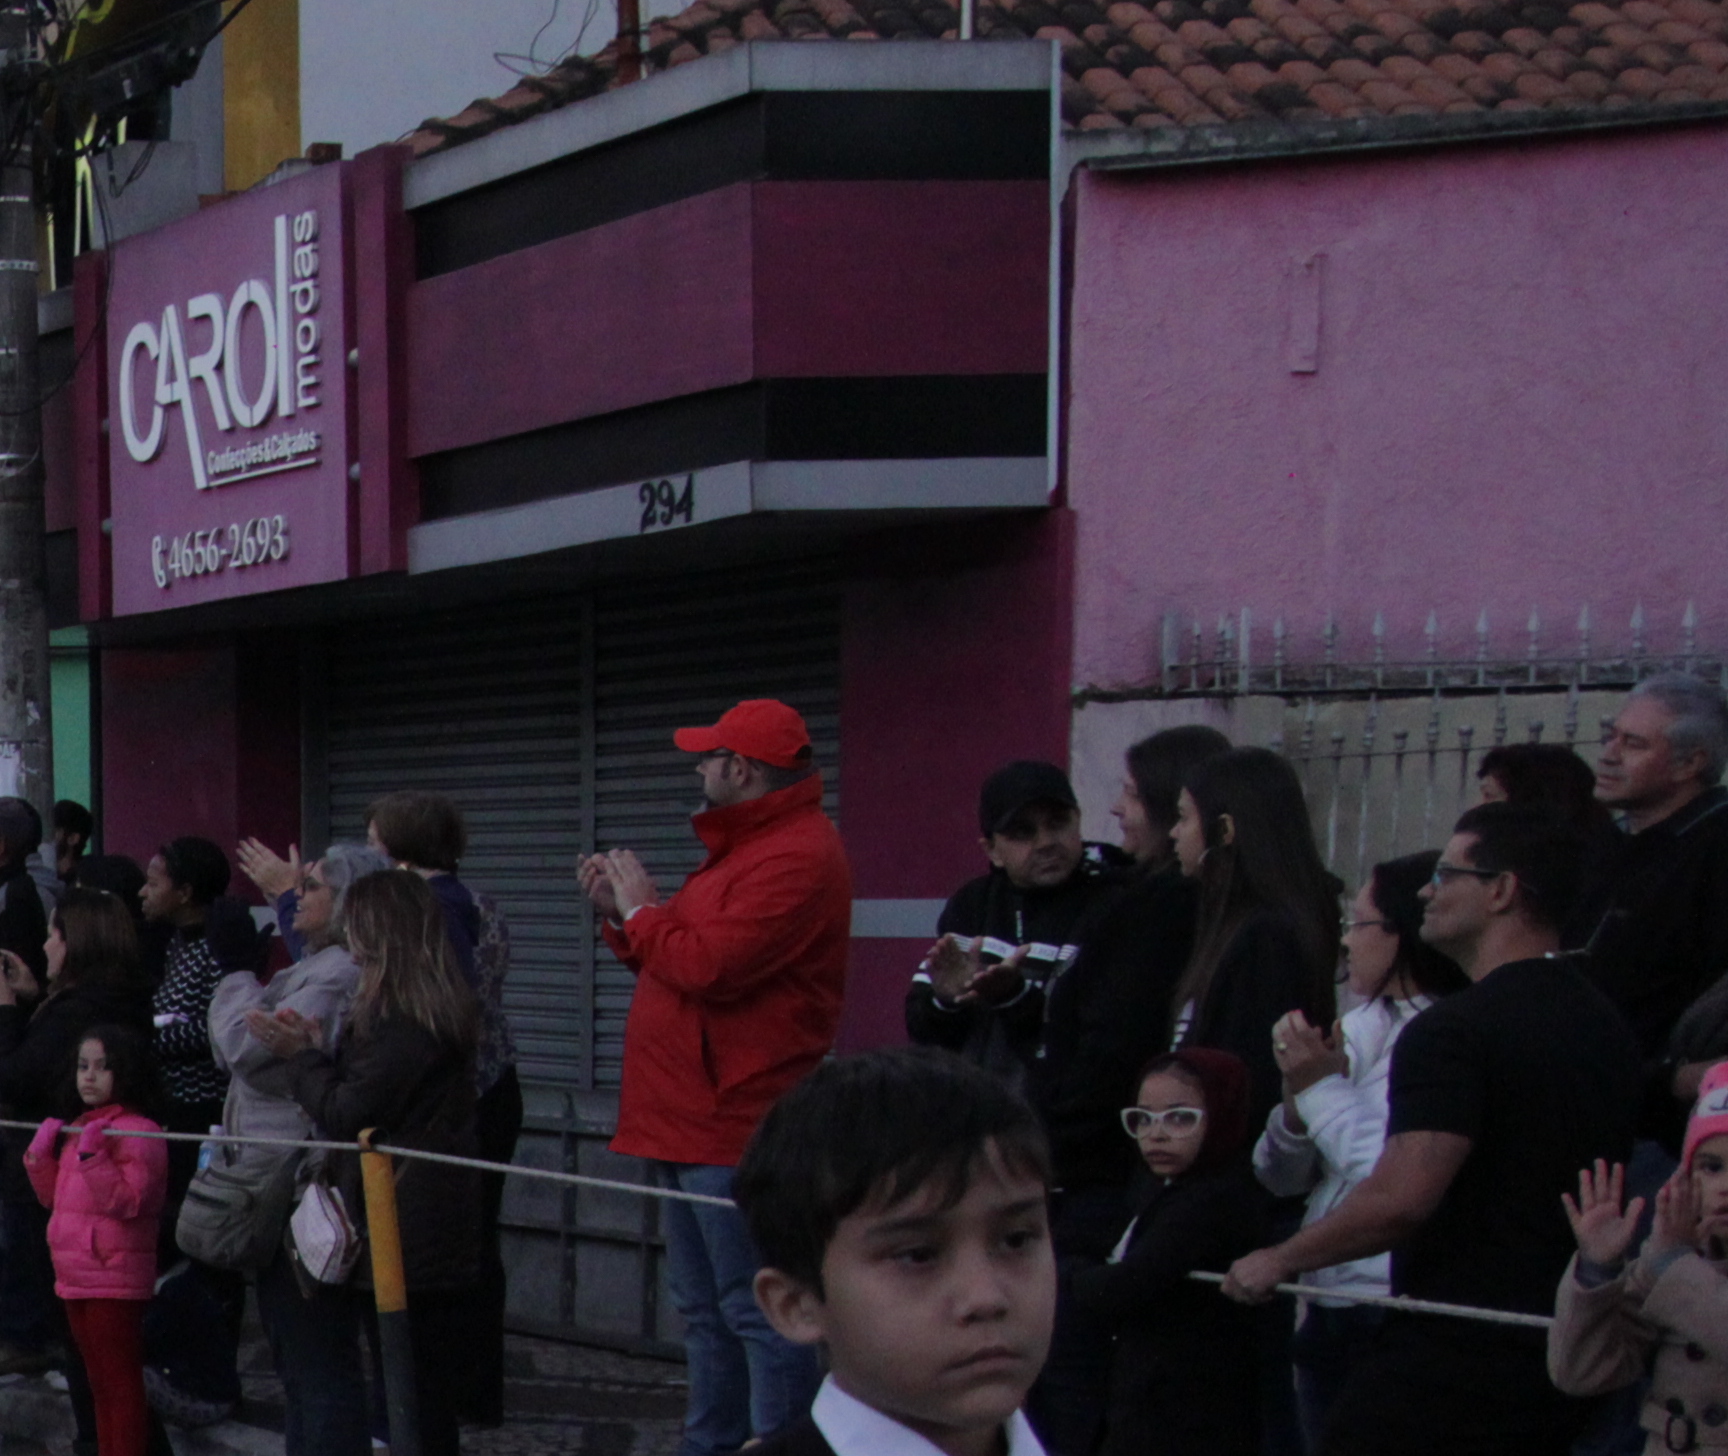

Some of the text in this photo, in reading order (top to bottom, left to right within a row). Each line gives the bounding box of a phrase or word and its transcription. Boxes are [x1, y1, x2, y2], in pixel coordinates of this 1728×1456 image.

[294, 210, 321, 408] modas
[639, 473, 694, 533] 294
[169, 515, 289, 578] 4656-2693
